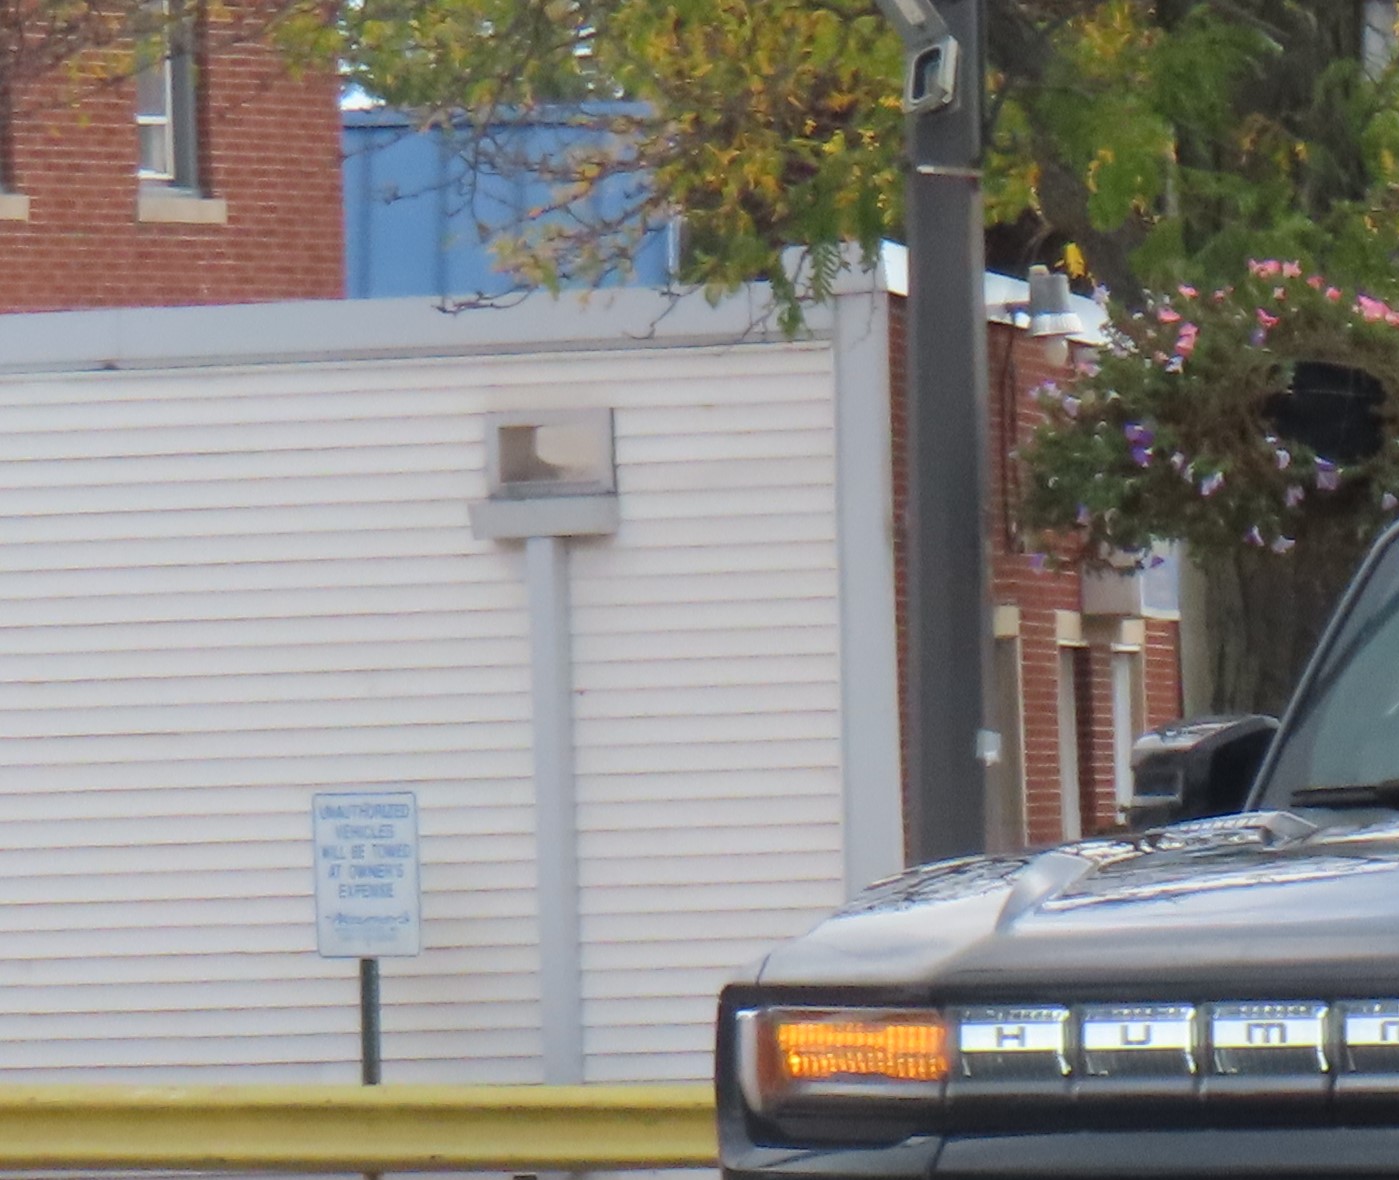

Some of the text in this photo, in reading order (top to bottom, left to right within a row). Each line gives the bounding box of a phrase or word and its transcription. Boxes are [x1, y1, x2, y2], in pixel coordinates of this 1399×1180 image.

[320, 804, 409, 819] UNAUTHORIZED
[336, 825, 394, 839] VEHICLES
[322, 844, 410, 859] WILL BE TOWED
[329, 864, 342, 878] AT
[339, 884, 394, 898] EXPENSE
